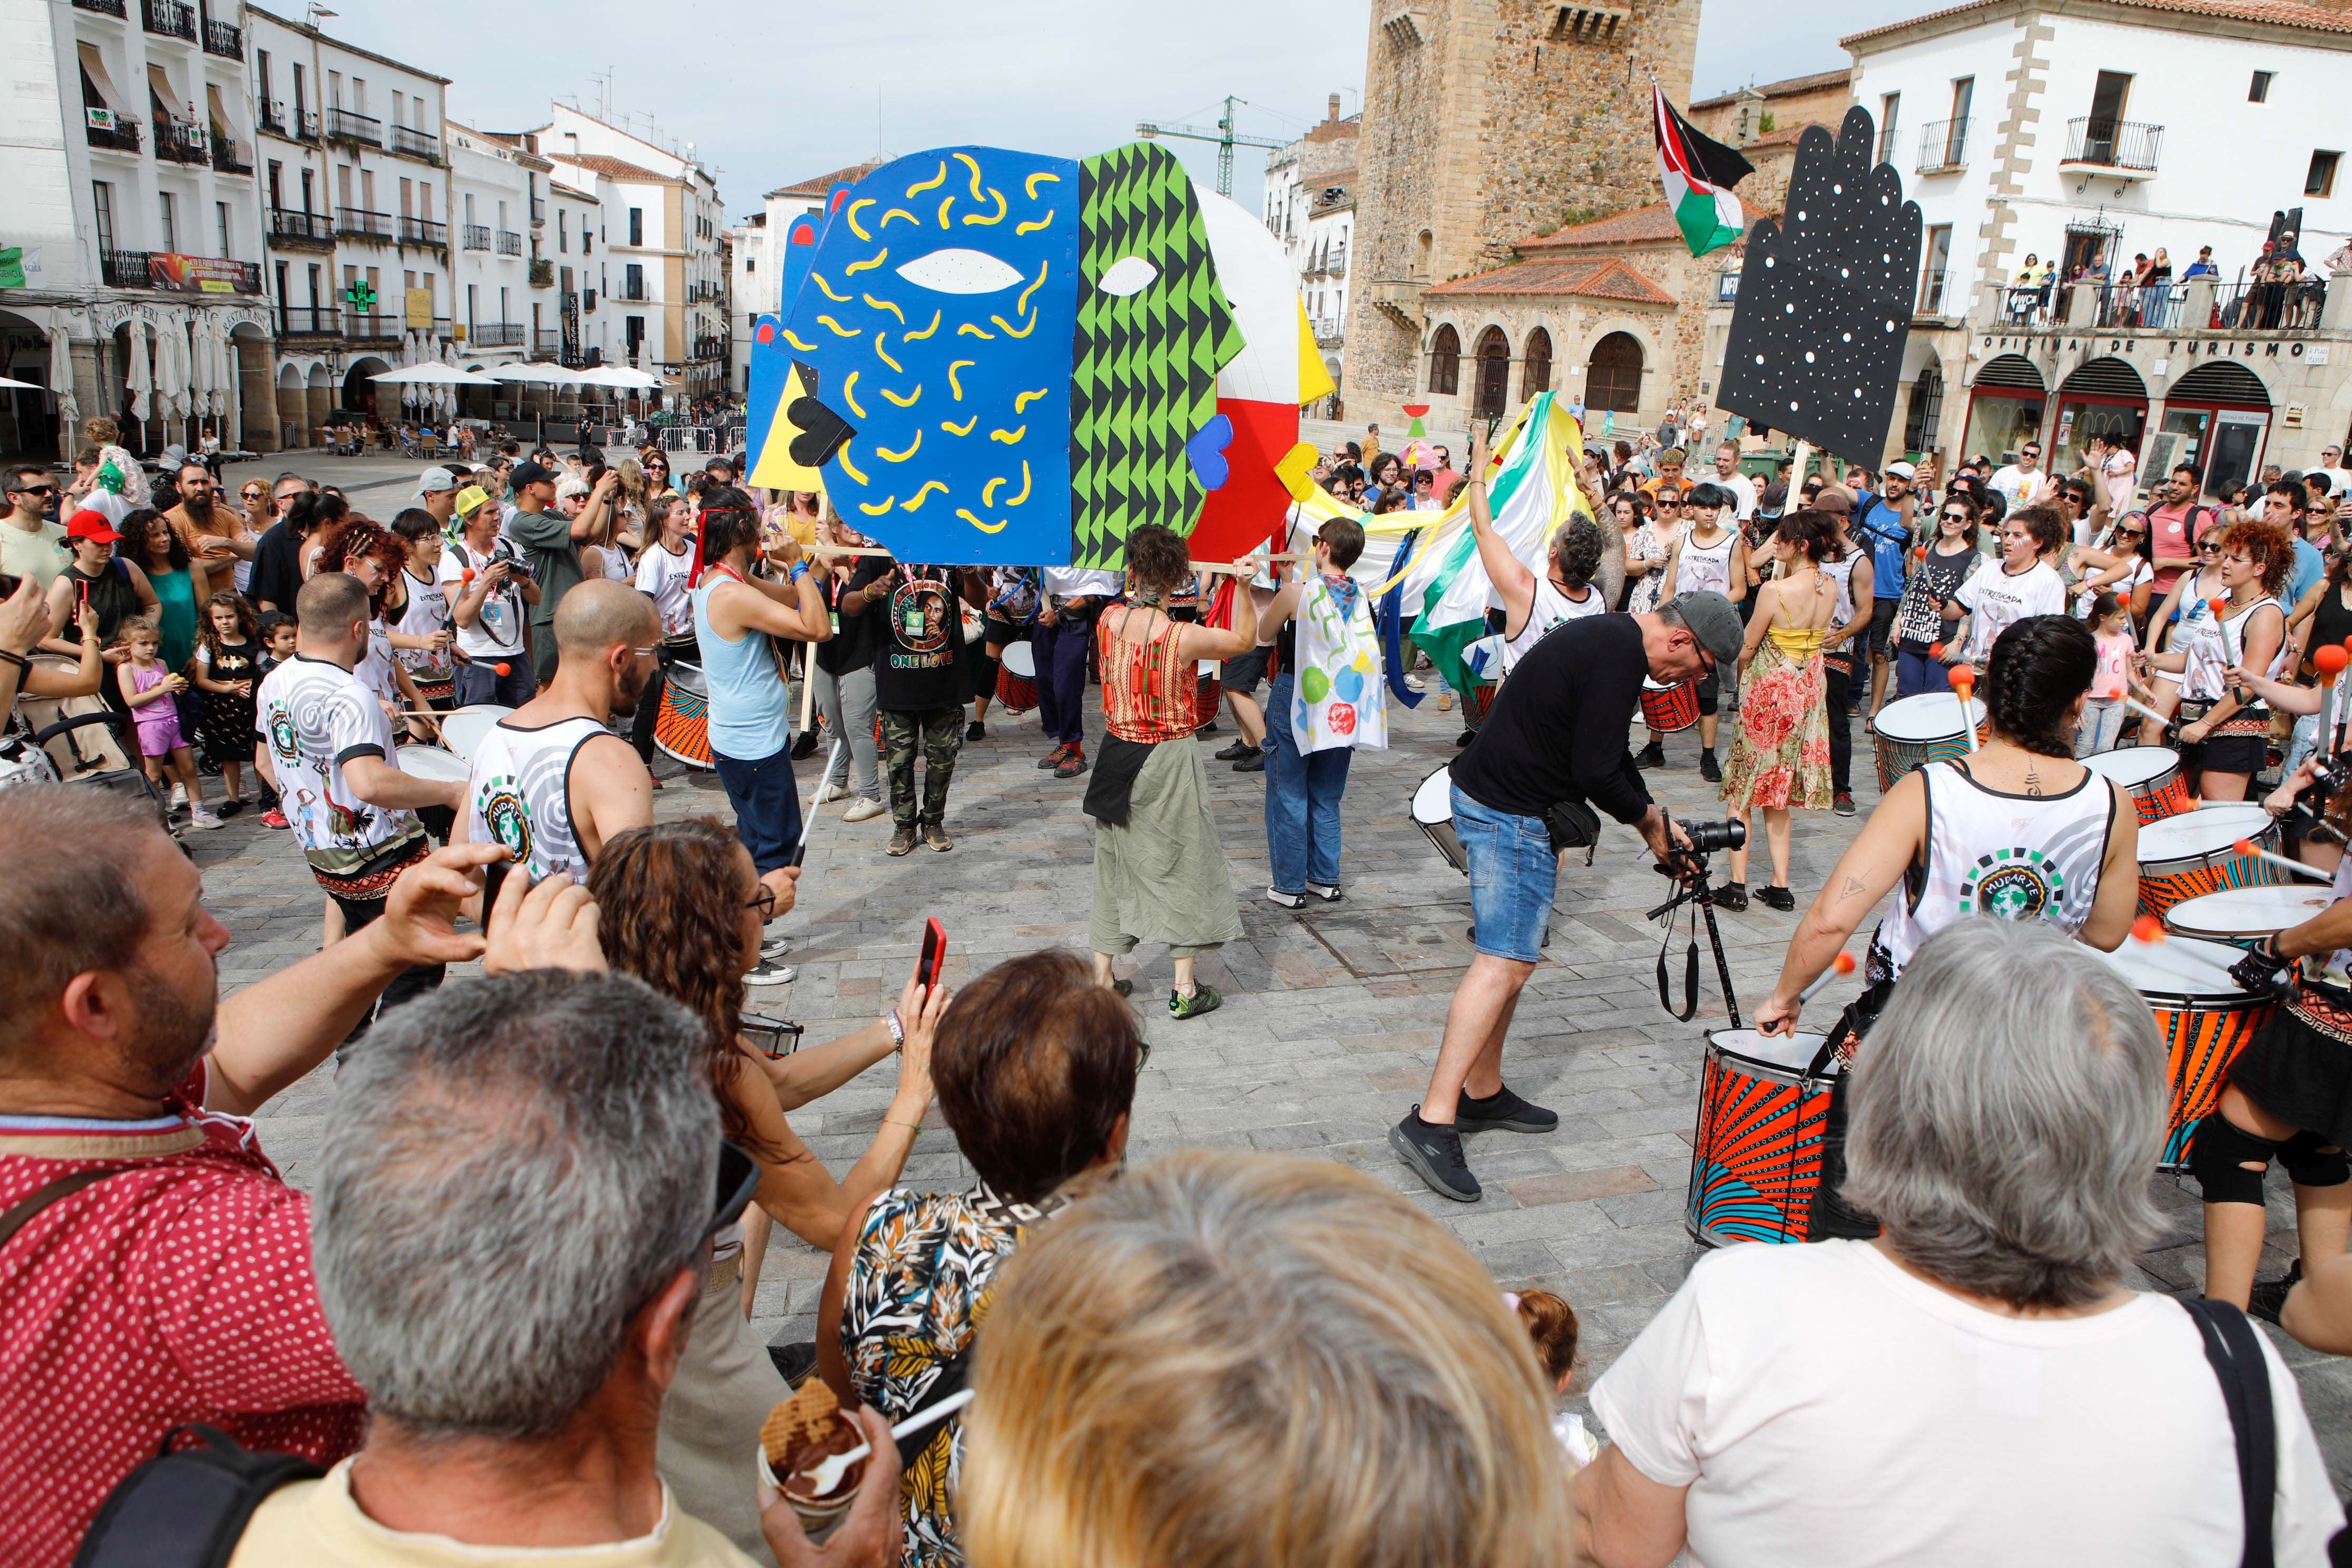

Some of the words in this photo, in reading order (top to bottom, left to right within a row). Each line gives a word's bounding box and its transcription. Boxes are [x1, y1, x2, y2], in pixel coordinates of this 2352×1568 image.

[2018, 294, 2033, 305] WC
[106, 303, 159, 328] CERVECERI
[223, 309, 270, 335] RESTAURANTE
[1984, 337, 2077, 351] OFICINA
[2111, 340, 2135, 352] DE
[2169, 341, 2304, 357] TURISMO
[1685, 555, 1719, 564] EXTRETUCADA
[1978, 587, 2023, 606] EXTRETUCADA
[890, 654, 919, 669] ONE
[922, 650, 953, 668] LOVE
[1985, 874, 2039, 896] MUDARTE
